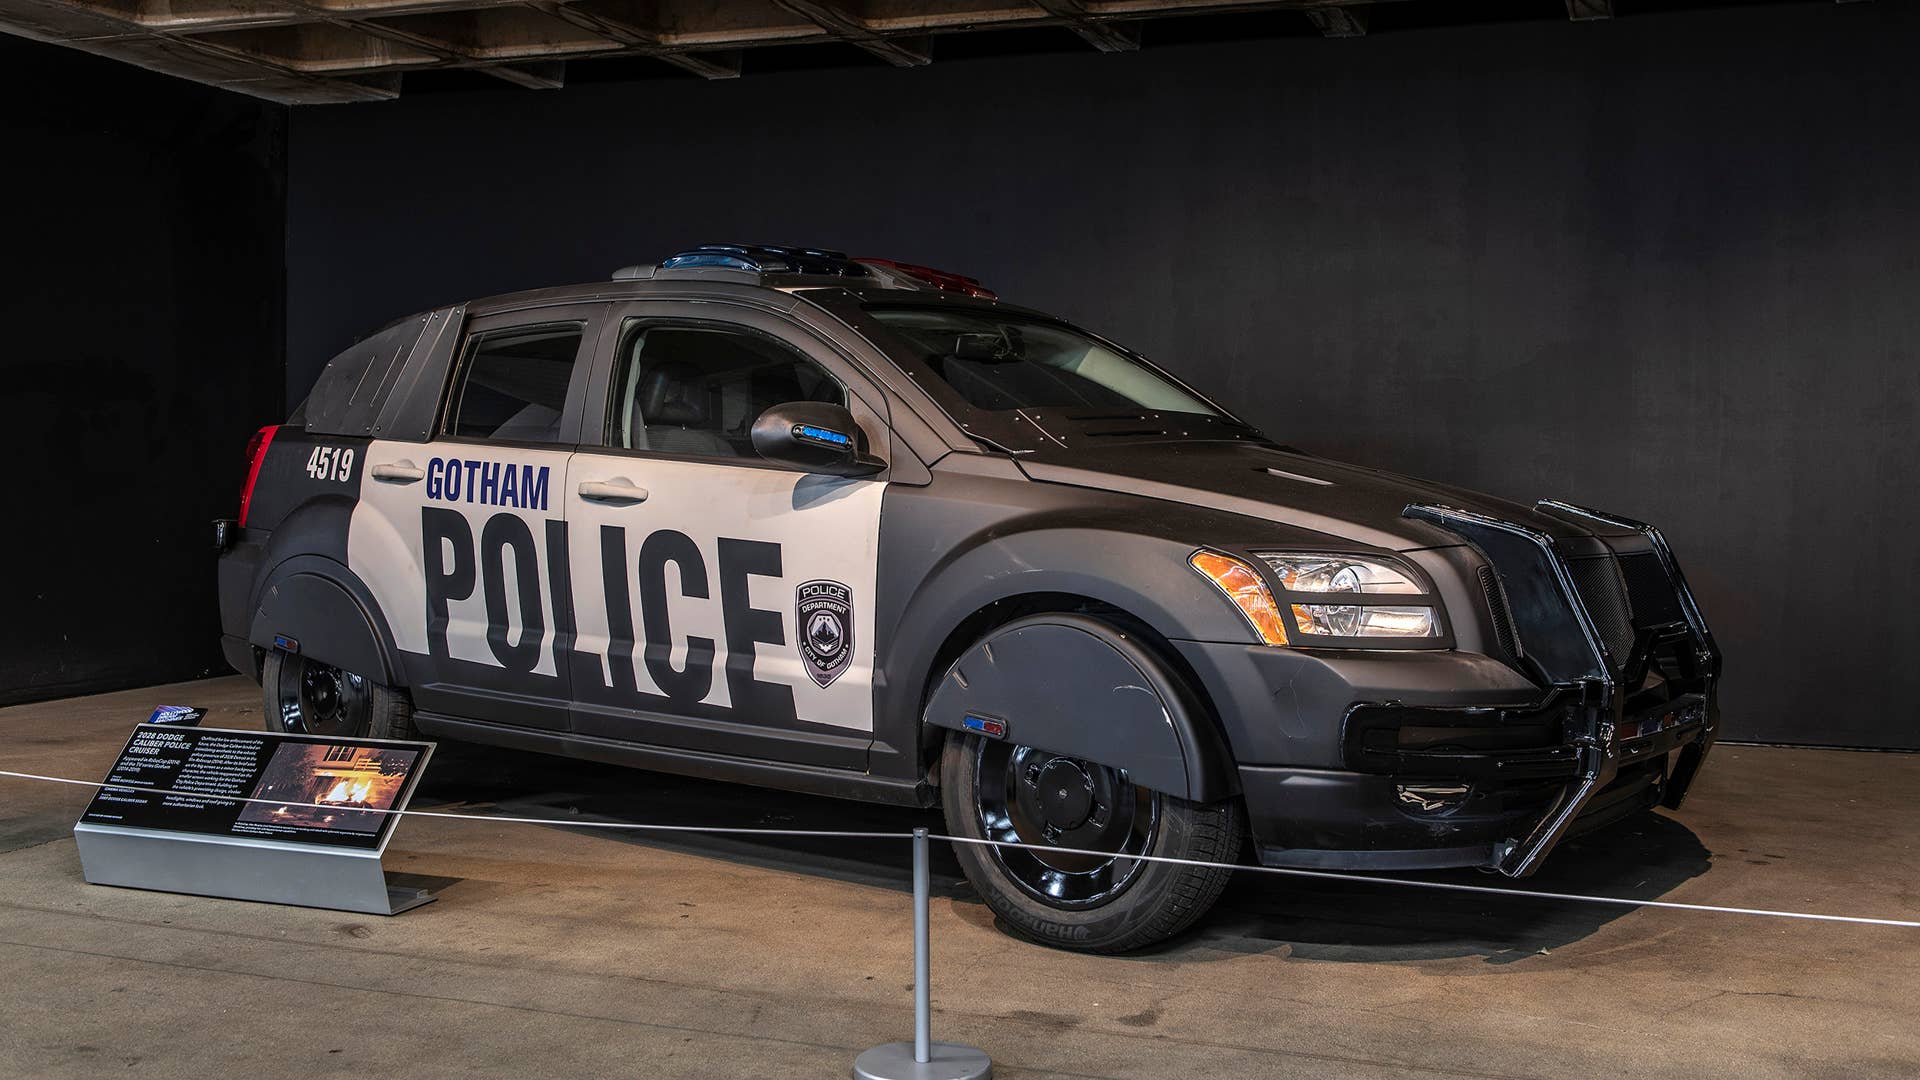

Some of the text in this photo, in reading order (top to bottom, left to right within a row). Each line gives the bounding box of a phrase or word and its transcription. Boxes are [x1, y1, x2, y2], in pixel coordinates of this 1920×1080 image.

[307, 446, 355, 483] 4519
[426, 457, 549, 511] GOTHAM
[802, 585, 845, 599] POLICE
[421, 506, 797, 720] POLICE
[802, 602, 846, 614] DEPARTMENT
[805, 646, 817, 661] CITY
[826, 649, 848, 669] GOTHAM
[128, 747, 160, 755] CRUISER
[133, 739, 164, 747] CALIBER
